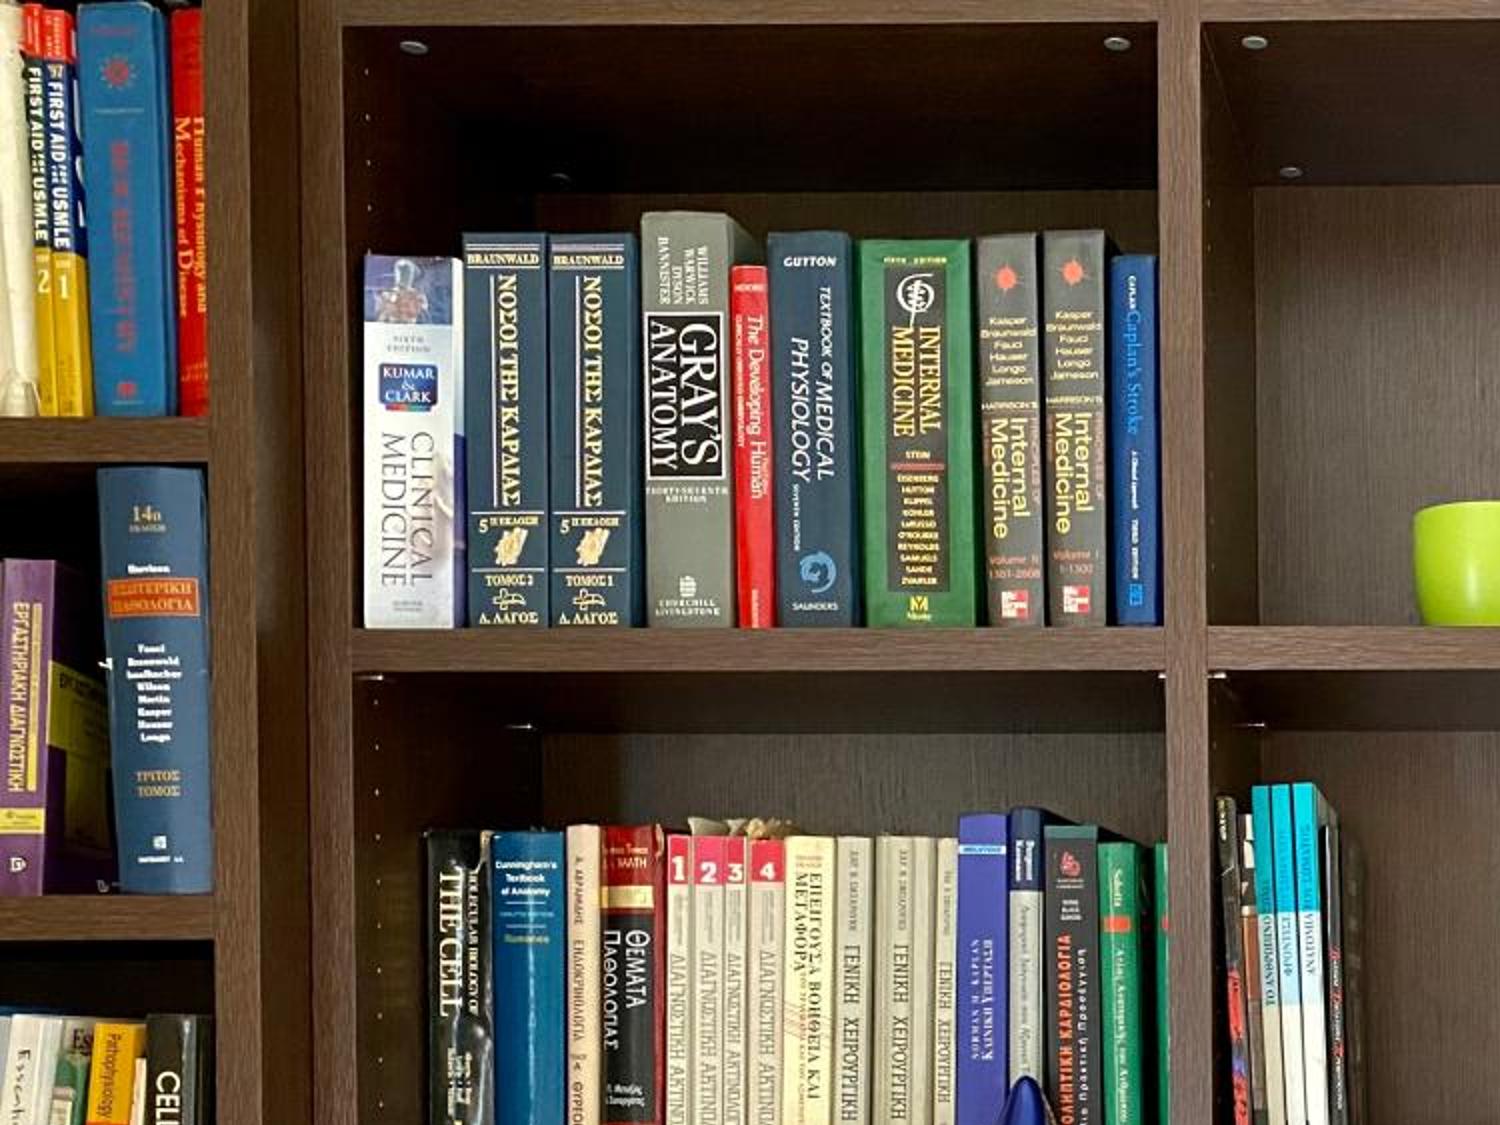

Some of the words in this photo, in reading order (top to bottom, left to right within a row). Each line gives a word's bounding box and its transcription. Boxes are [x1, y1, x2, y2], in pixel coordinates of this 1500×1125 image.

[28, 67, 44, 117] FIRST
[49, 82, 64, 128] FIRST
[31, 120, 45, 151] AID
[50, 134, 65, 161] AID
[33, 176, 49, 241] USMLE
[52, 187, 70, 248] USMLE
[38, 268, 50, 293] 2
[60, 275, 68, 300] 1
[467, 253, 540, 265] BRAUNWALD
[553, 254, 625, 266] BRAUNWALD
[658, 236, 671, 304] BANNISTER
[672, 265, 683, 304] DYSON
[684, 247, 696, 304] WARWICK
[697, 246, 709, 304] WILLIAMS
[499, 275, 519, 350] ΝΟΣΟΙ
[584, 275, 603, 351] ΝΟΣΟΙ
[747, 314, 764, 343] The
[819, 286, 833, 357] TEXTBOOK
[1122, 309, 1142, 377] Caplan's
[382, 367, 436, 380] KUMAR
[384, 390, 432, 403] CLARK
[499, 355, 519, 403] ΤΗΣ
[584, 355, 603, 404] ΤΗΣ
[650, 320, 678, 471] ANATOMY
[681, 322, 723, 465] GRAY'S
[745, 348, 763, 435] Developing
[821, 360, 833, 379] OF
[892, 326, 914, 436] MEDICINE
[919, 326, 941, 434] INTERNAL
[790, 337, 810, 482] PHYSIOLOGY
[815, 381, 834, 480] MEDICAL
[1125, 383, 1141, 435] Stroke
[499, 406, 519, 507] ΚΑΡΔΙΑΣ
[584, 406, 603, 508] ΚΑΡΔΙΑΣ
[750, 441, 766, 499] Human
[991, 418, 1009, 539] Medicine
[1012, 418, 1031, 517] Internal
[1054, 412, 1072, 534] Medicine
[1074, 412, 1094, 511] Internal
[381, 432, 408, 587] MEDICINE
[410, 431, 434, 586] CLINICAL
[111, 596, 194, 613] ΠΑΘΟΛΟΓΙΑ
[112, 581, 193, 597] ΕΣΩΤΕΡΙΚΗ
[497, 612, 538, 624] ΛΑΓΟΣ
[577, 612, 618, 624] ΛΑΓΟΣ
[9, 601, 30, 700] ΕΡΓΑΣΤΗΡΙΑΚΗ
[7, 702, 26, 793] ΔΙΑΓΝΩΣΤΙΚΗ
[438, 867, 463, 935] THE
[671, 855, 687, 881] 1
[699, 861, 717, 883] 2
[727, 863, 744, 881] 3
[759, 861, 776, 882] 4
[793, 871, 809, 973] ΜΕΤΑΦΟΡΑ
[806, 872, 823, 976] ΕΠΕΙΓΟΥΣΑ
[1303, 912, 1318, 976] ΑΝΑΤΟΜΙΑ
[438, 936, 463, 1017] CELL
[468, 946, 480, 996] BIOLOGY
[602, 929, 621, 1050] ΠΑΘΟΛΟΓΙΑΣ
[624, 929, 650, 1009] ΘΕΜΑΤΑ
[725, 952, 742, 1044] ΔΙΑΓΝΩΣΤΙΚΗ
[756, 949, 775, 1056] ΔΙΑΓΝΩΣΤΙΚΗ
[842, 944, 860, 1004] ΓΕΝΙΚΗ
[892, 944, 909, 1003] ΓΕΝΙΚΗ
[938, 960, 952, 1009] ΓΕΝΙΚΗ
[980, 937, 993, 1003] ΥΠΕΡΤΑΣΗ
[1056, 934, 1073, 1039] ΚΑΡΔΙΟΛΟΓΙΑ
[1076, 947, 1089, 1031] Προσέγγιση
[468, 997, 480, 1016] OF
[669, 953, 687, 1064] ΔΙΑΓΝΩΣΤΙΚΗ
[698, 950, 718, 1059] ΔΙΑΓΝΩΣΤΙΚΗ
[806, 980, 822, 1063] ΒΟΗΘΕΙΑ
[980, 1006, 993, 1061] ΚΛΙΝΙΚΗ
[96, 1032, 122, 1119] Pathophysiology
[806, 1067, 822, 1100] ΚΑΙ
[841, 1016, 860, 1122] ΧΕΙΡΟΥΡΓΙΚΗ
[890, 1015, 908, 1120] ΧΕΙΡΟΥΡΓΙΚΗ
[937, 1018, 951, 1103] ΧΕΙΡΟΥΡΓΙΚΗ
[1076, 1036, 1090, 1102] Πρακτική
